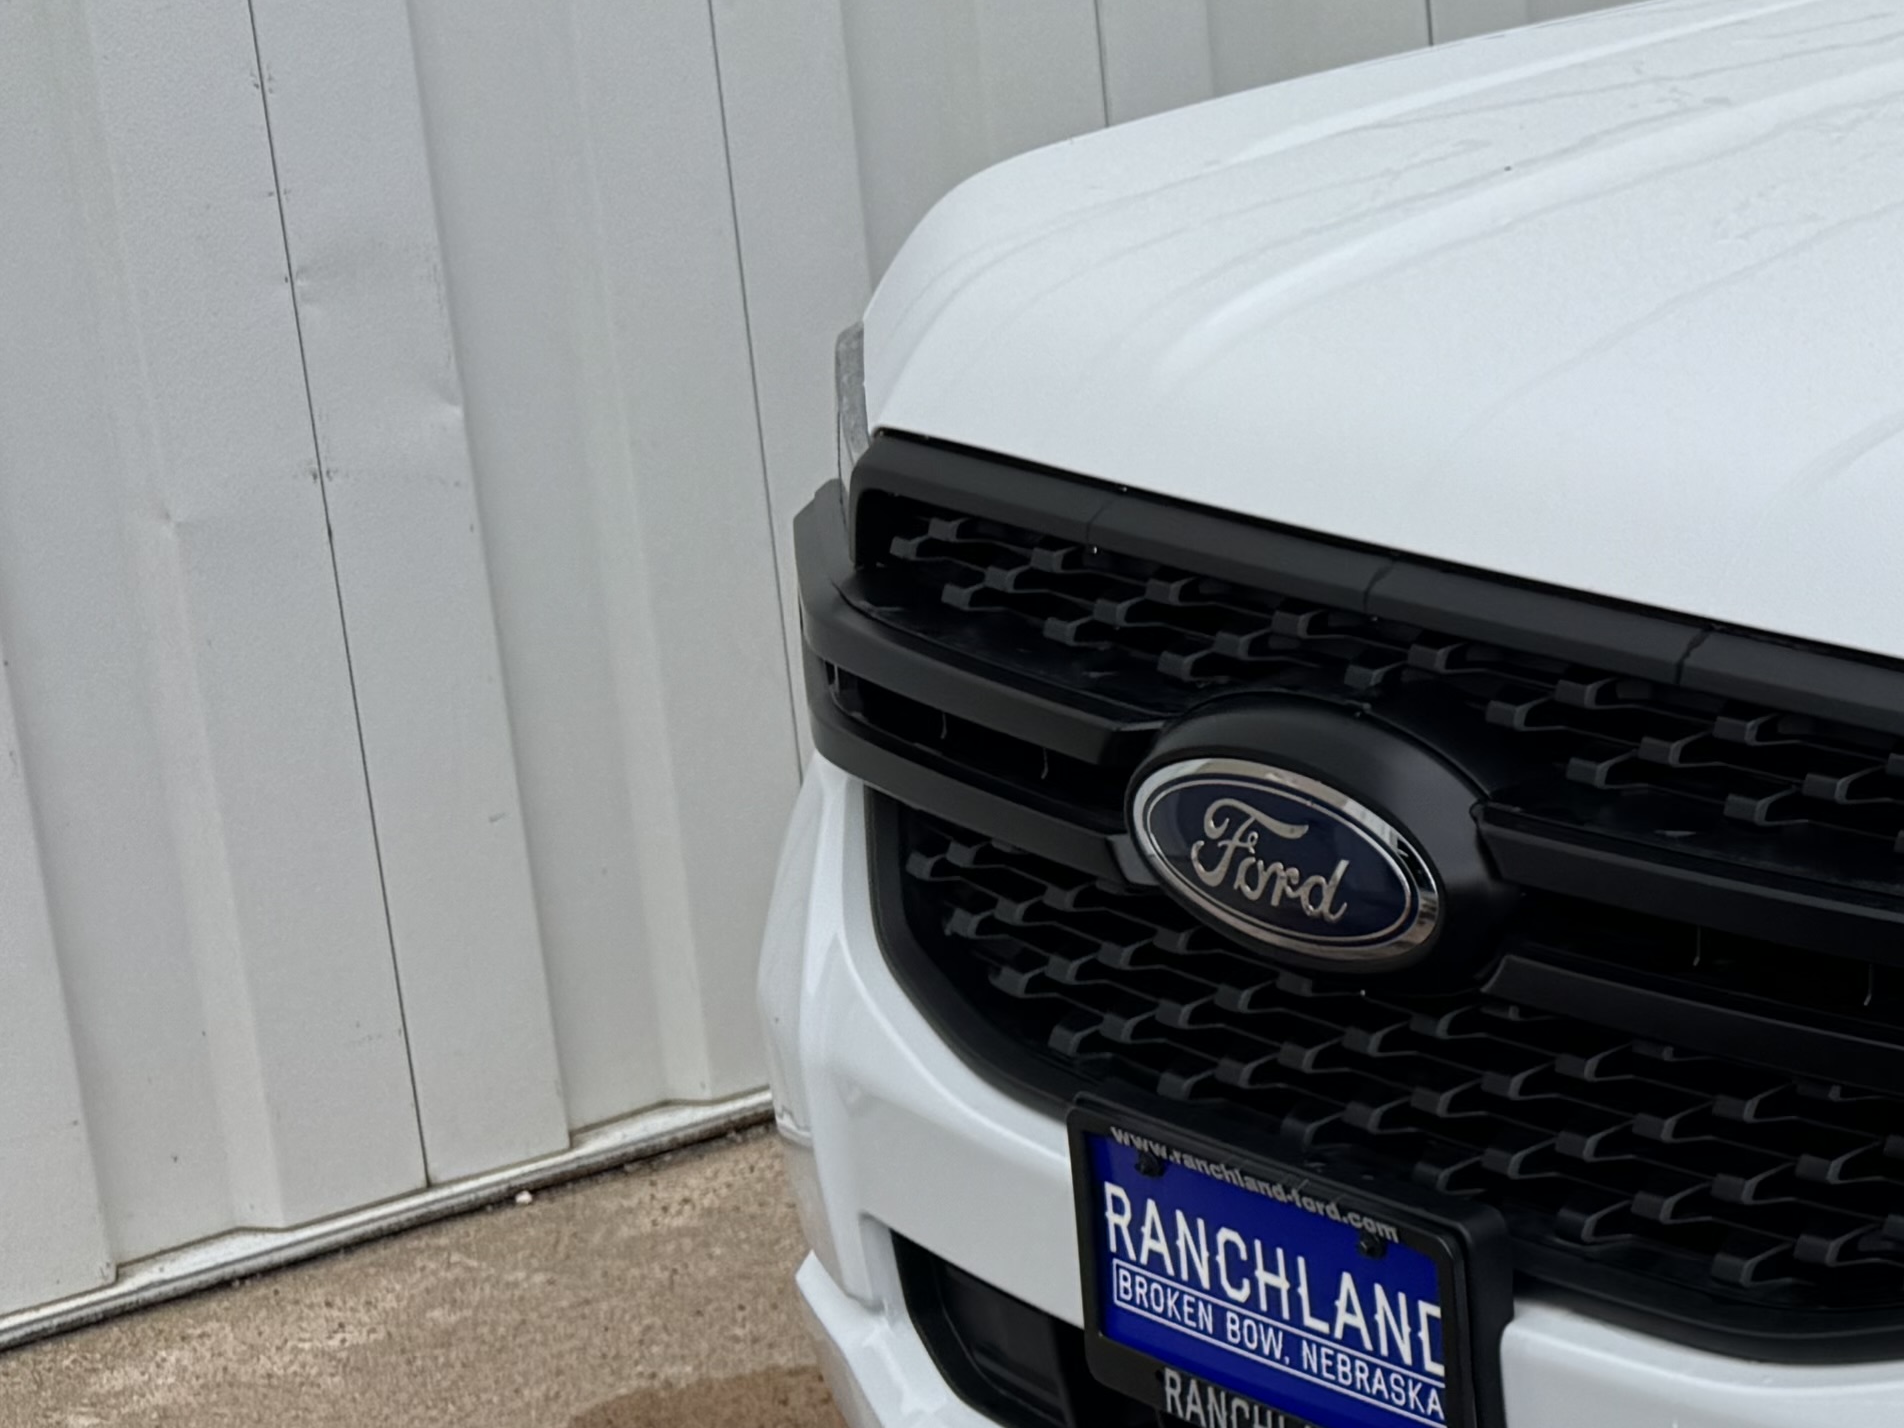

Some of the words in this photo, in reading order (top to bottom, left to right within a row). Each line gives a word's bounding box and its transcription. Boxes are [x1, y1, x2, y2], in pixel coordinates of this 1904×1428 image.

[1191, 797, 1348, 924] Ford
[1118, 1267, 1213, 1336] BROKEN
[1225, 1310, 1290, 1366] BOW,
[1301, 1339, 1446, 1421] NEBRASKA
